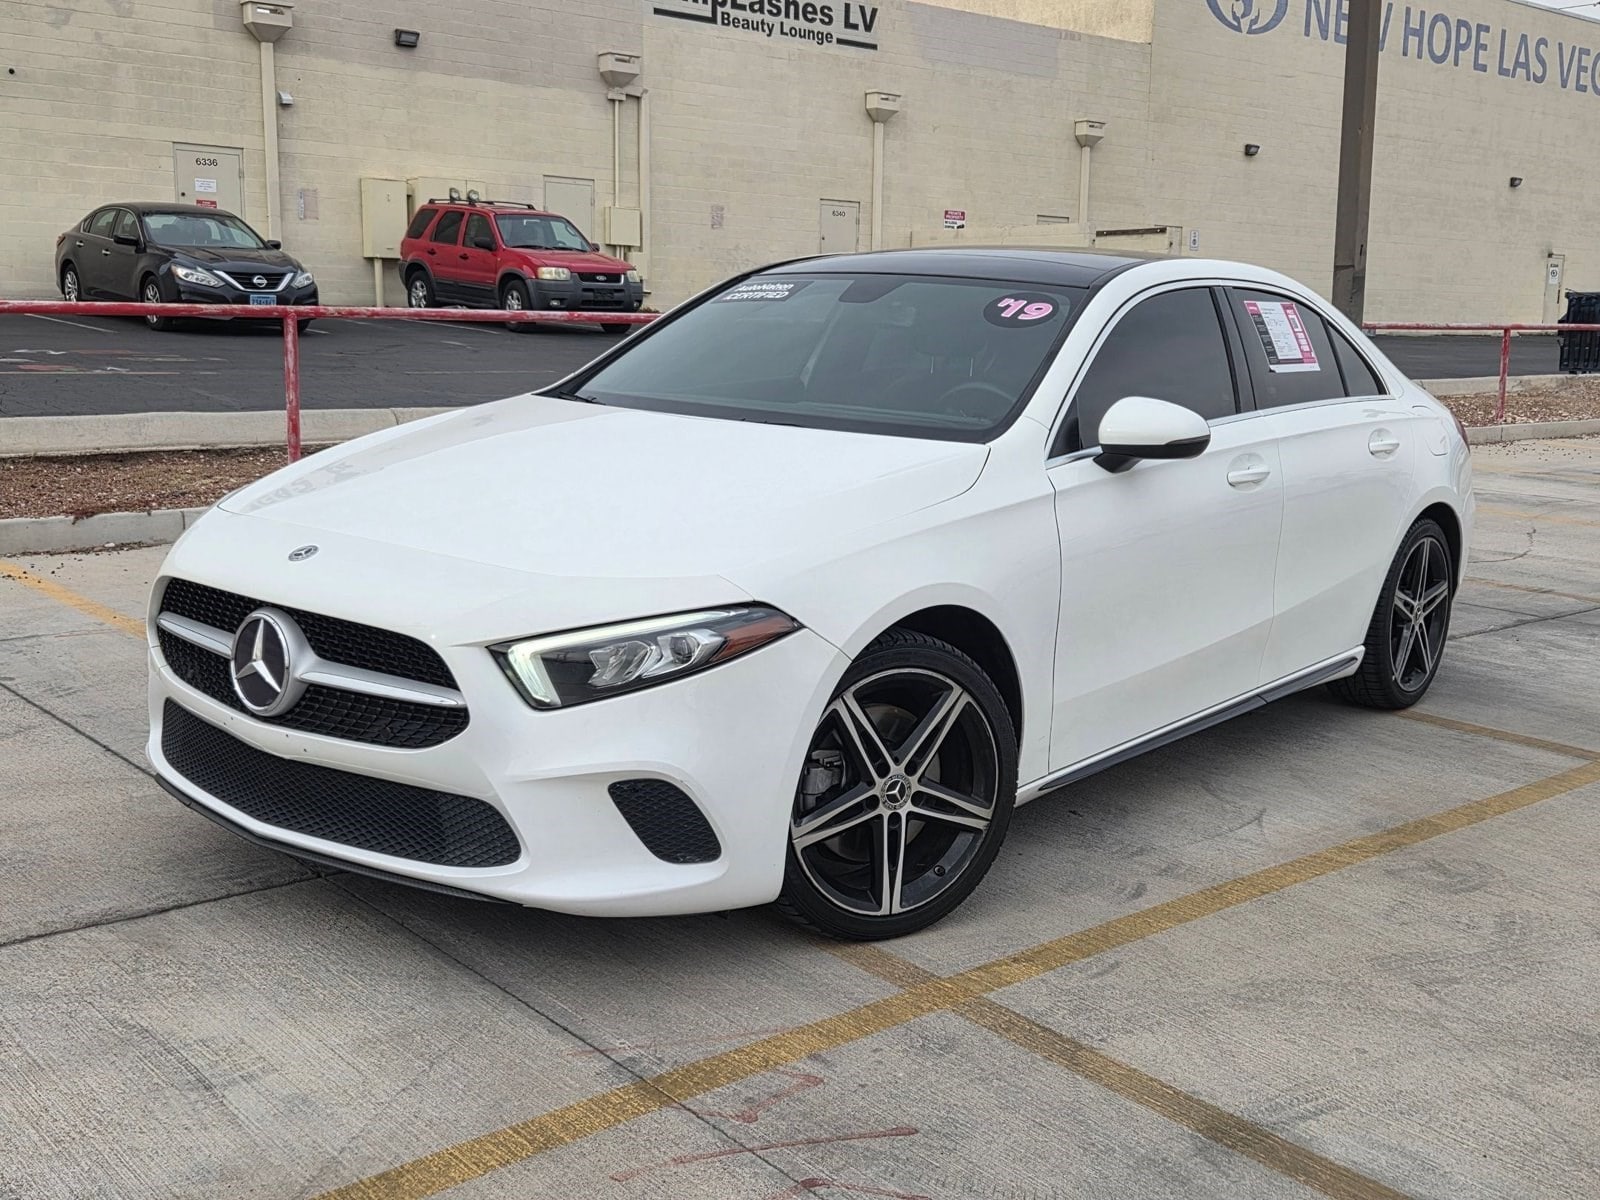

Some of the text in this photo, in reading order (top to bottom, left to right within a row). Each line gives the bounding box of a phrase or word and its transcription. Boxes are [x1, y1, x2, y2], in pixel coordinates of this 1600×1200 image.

[721, 11, 834, 45] Beauty Lounge
[844, 2, 878, 33] LV
[1402, 7, 1491, 72] HOPE
[1498, 29, 1548, 84] LAS
[196, 158, 218, 166] 6336
